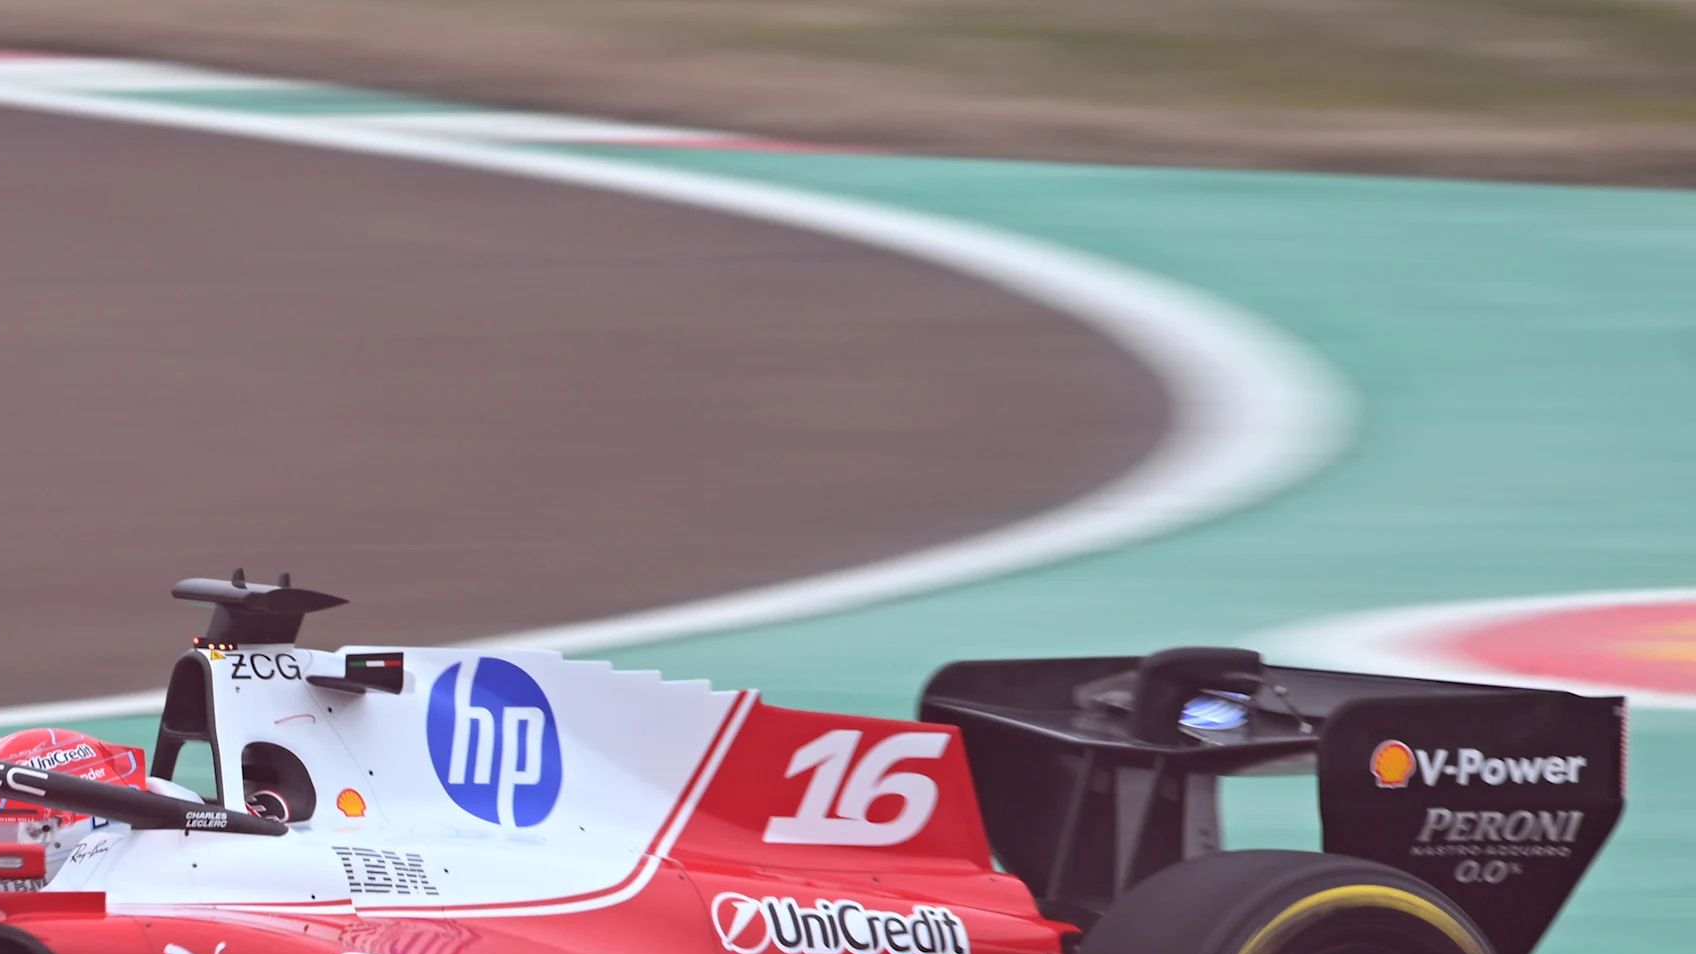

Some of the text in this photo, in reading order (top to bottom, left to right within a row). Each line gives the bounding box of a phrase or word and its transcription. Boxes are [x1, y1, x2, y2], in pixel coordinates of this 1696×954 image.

[30, 744, 96, 769] UniCredit
[448, 656, 545, 827] hp
[1415, 748, 1587, 787] V-Power
[761, 729, 952, 847] 16
[186, 811, 228, 820] CHARLES
[186, 820, 228, 828] LECLERC
[1416, 807, 1585, 843] PERONI
[331, 845, 440, 897] IBM
